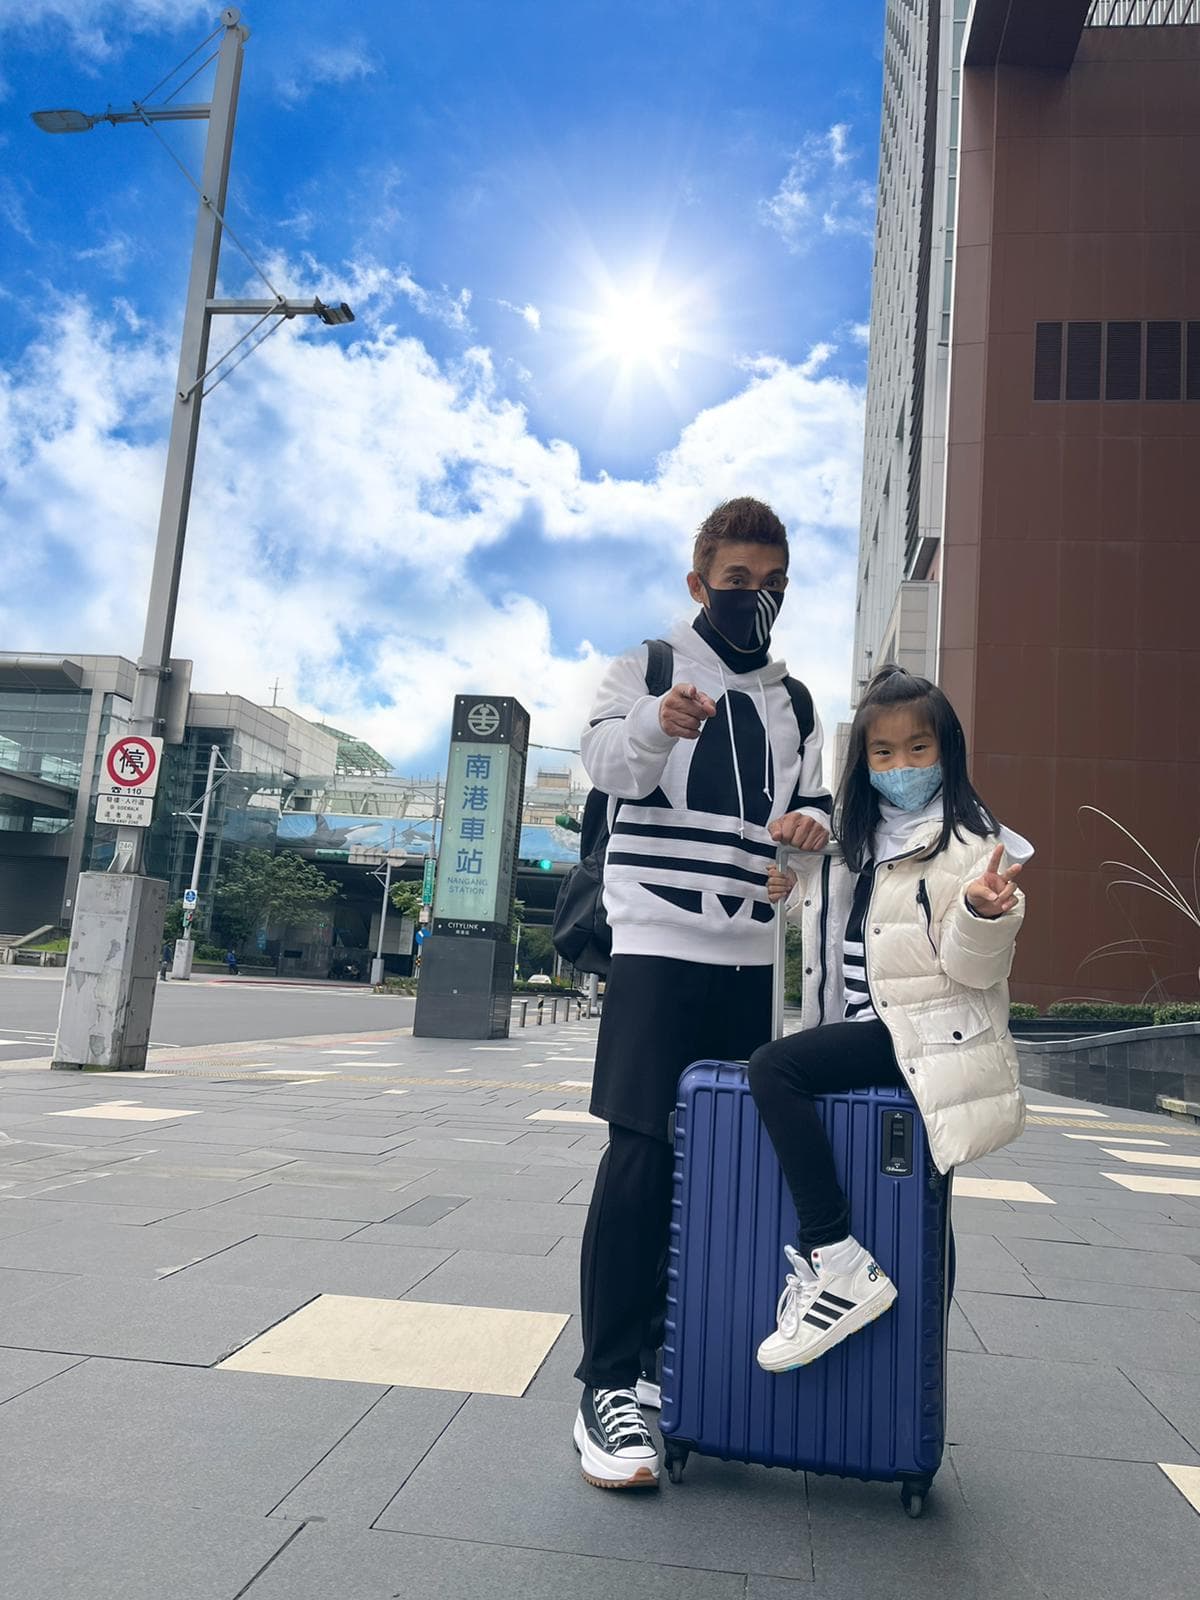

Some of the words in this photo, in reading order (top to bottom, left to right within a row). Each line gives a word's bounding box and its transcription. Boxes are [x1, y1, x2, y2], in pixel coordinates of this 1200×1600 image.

[119, 748, 145, 774] 停
[127, 787, 142, 795] 110
[456, 754, 491, 874] 南港車站
[447, 877, 488, 886] NANGANG
[448, 885, 485, 895] STATION
[447, 922, 479, 930] CITYLINK
